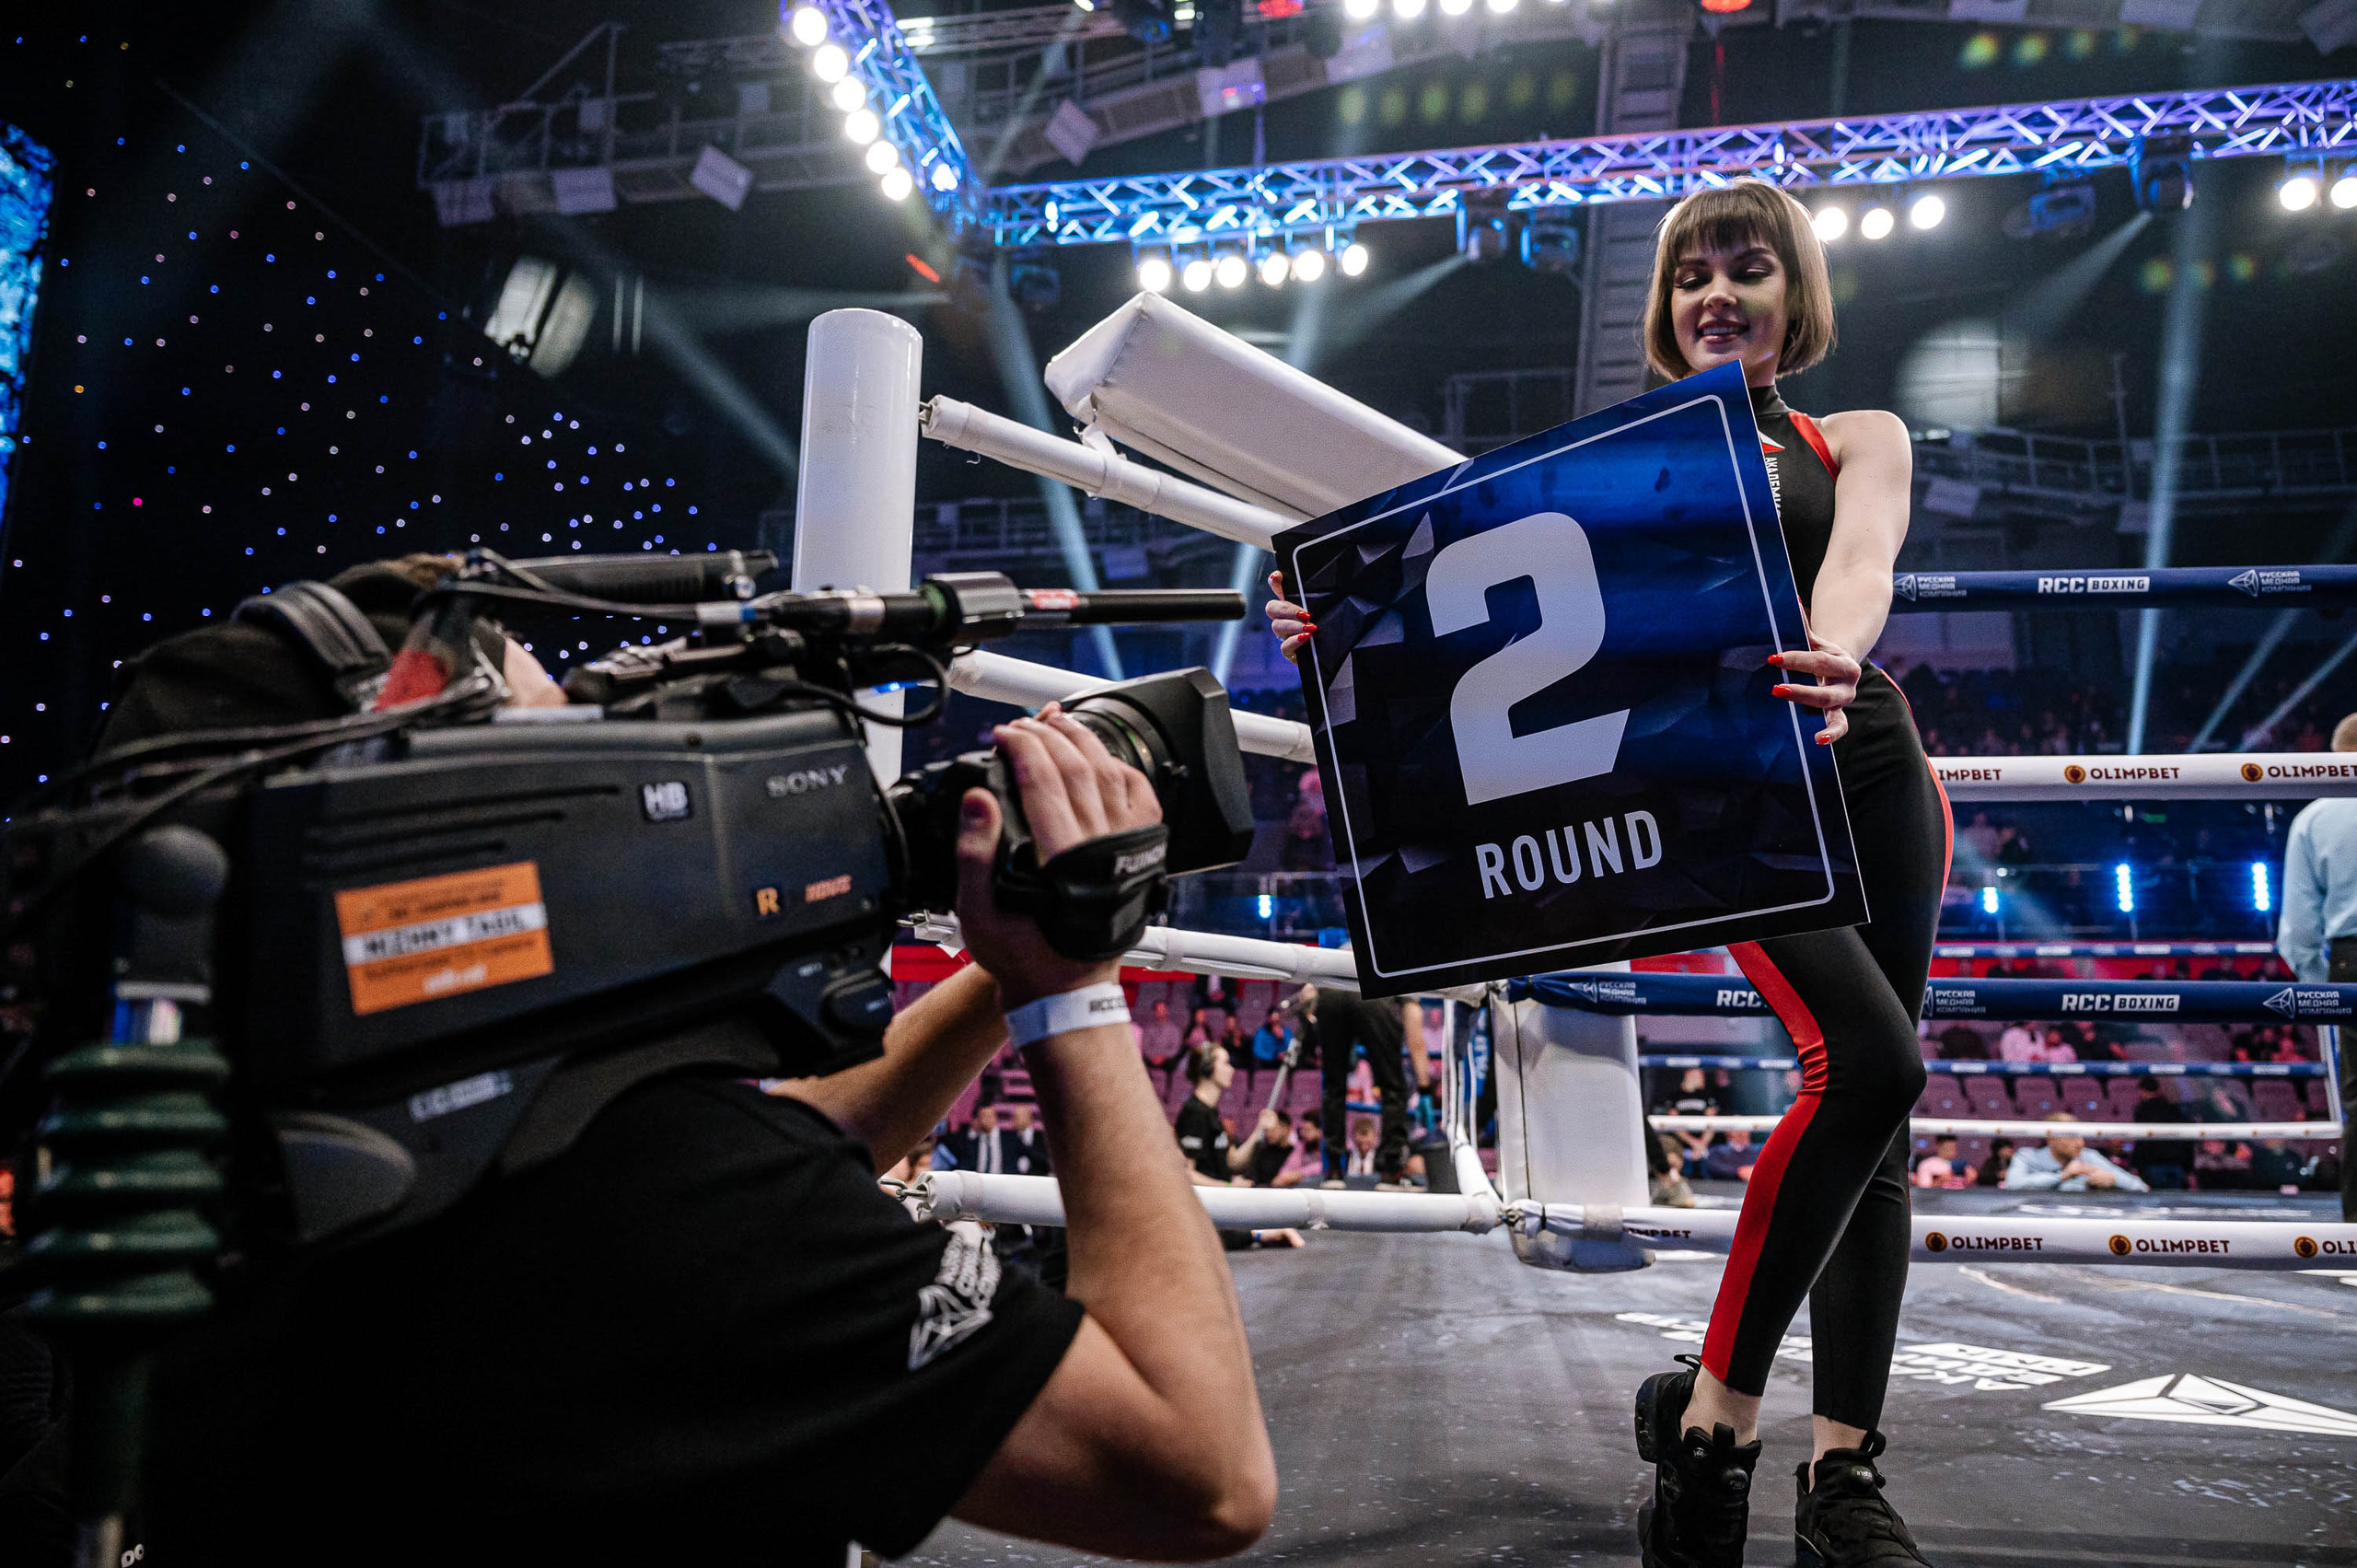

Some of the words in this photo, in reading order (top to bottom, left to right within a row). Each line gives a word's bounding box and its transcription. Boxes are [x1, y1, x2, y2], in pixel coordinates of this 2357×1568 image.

[2038, 576, 2084, 593] RCC
[2090, 578, 2147, 591] BOXING
[1426, 511, 1630, 806] 2
[766, 764, 848, 798] SONY
[1939, 769, 2002, 781] IMPBET
[2090, 767, 2180, 780] OLIMPBET
[2268, 765, 2357, 778] OLIMPBET
[1475, 809, 1663, 900] ROUND
[2061, 994, 2111, 1011] RCC
[2117, 996, 2177, 1010] BOXING
[1951, 1236, 2043, 1250] OLIMPBET
[2136, 1238, 2230, 1254] OLIMPBET
